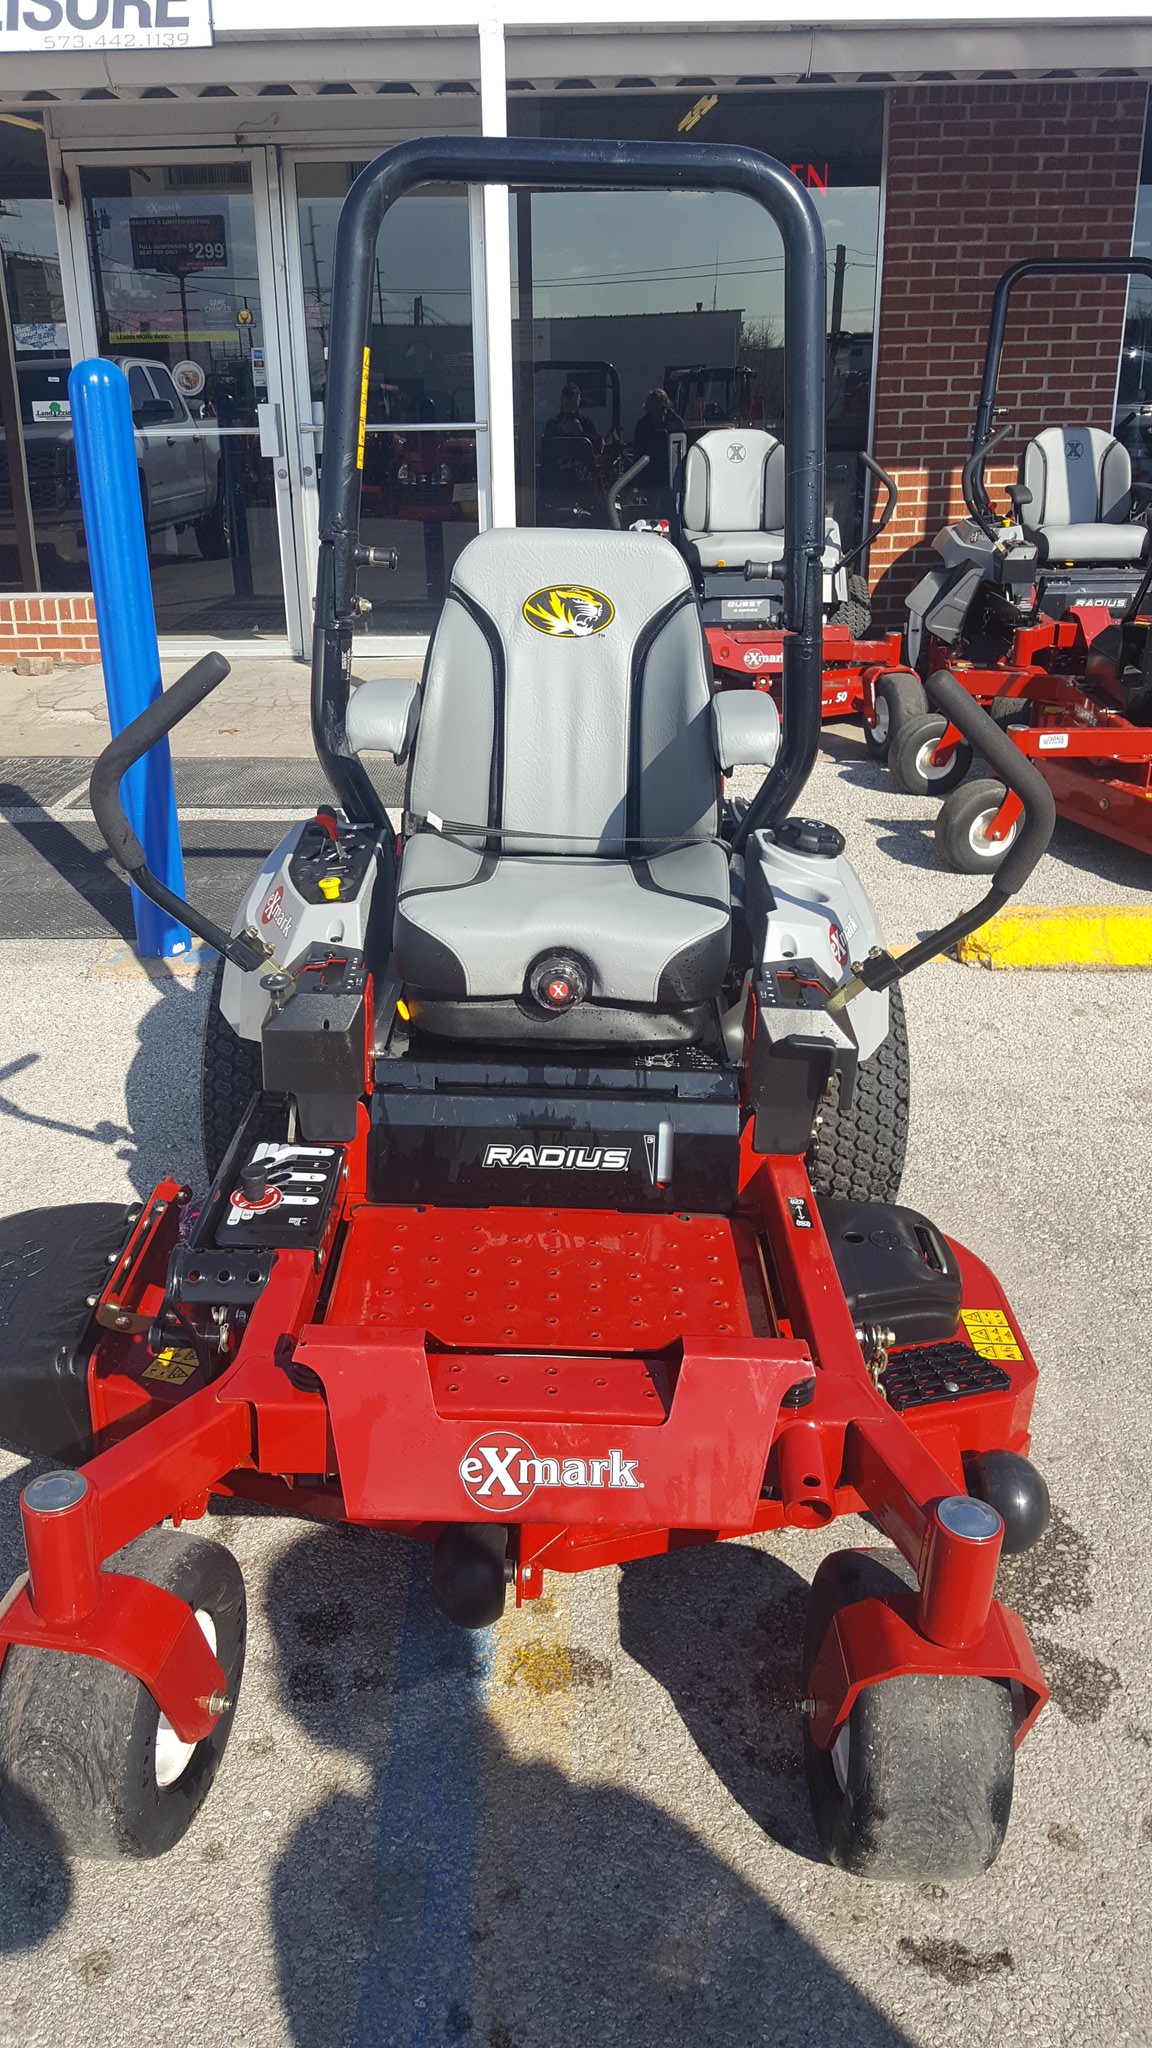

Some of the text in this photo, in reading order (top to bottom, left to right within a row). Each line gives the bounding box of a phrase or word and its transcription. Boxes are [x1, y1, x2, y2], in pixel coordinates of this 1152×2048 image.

[0, 0, 190, 31] ISURE
[44, 33, 189, 49] 573.442.1139
[1075, 598, 1127, 608] RADIUS
[836, 691, 848, 702] 50
[265, 889, 293, 939] eXmark
[829, 914, 859, 962] eXmark
[484, 1145, 630, 1171] RADIUS
[460, 1446, 640, 1496] eXmark
